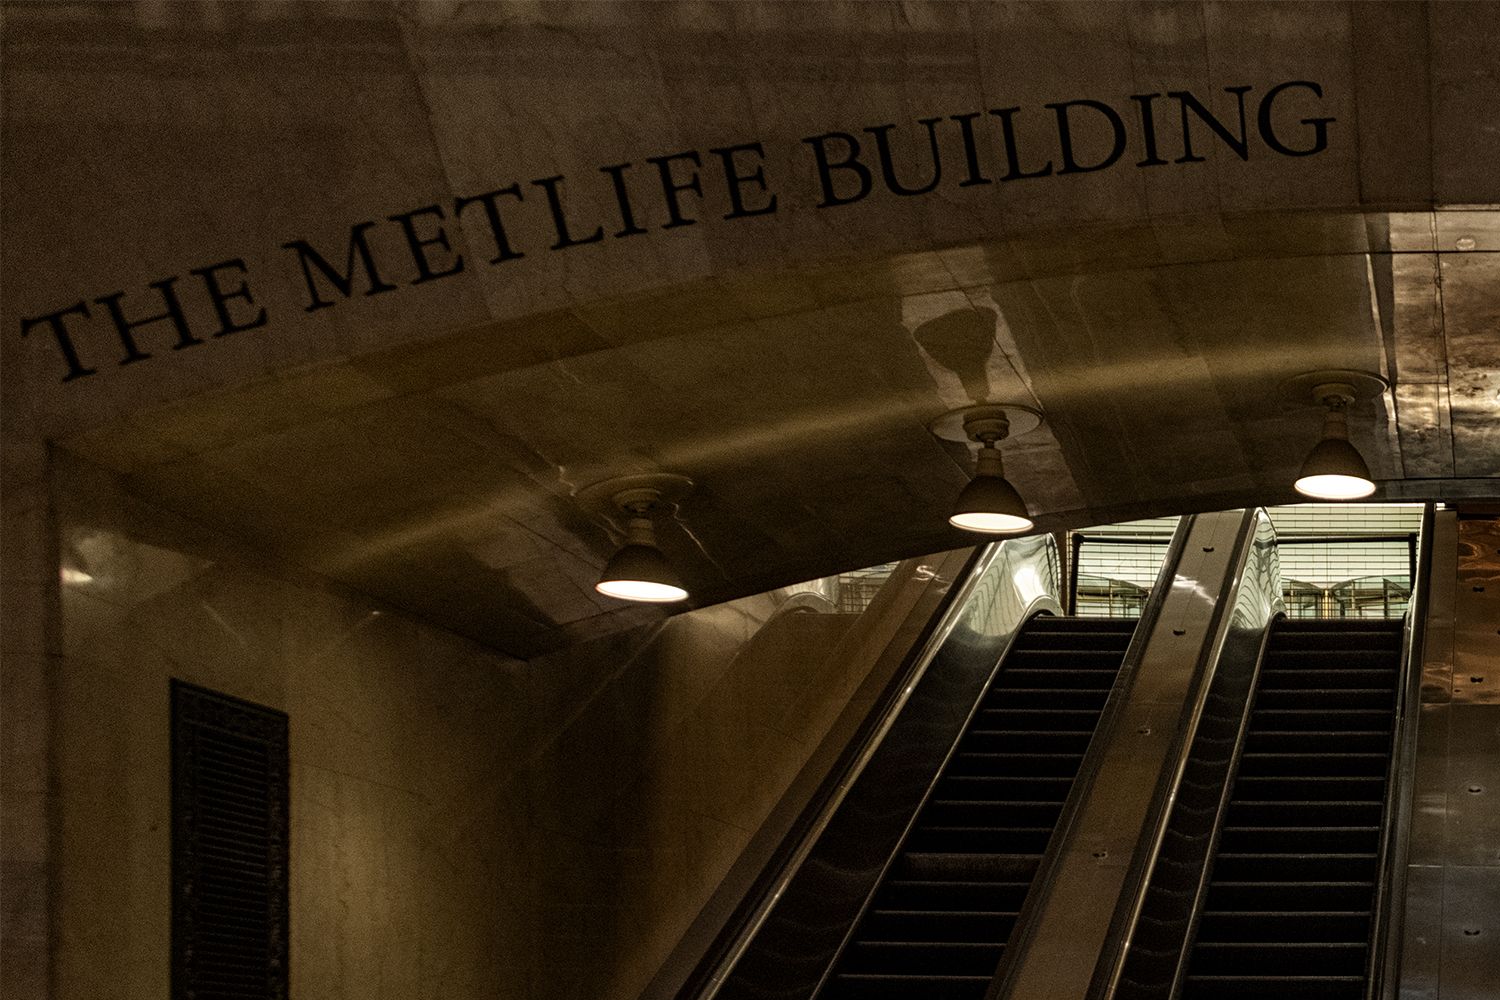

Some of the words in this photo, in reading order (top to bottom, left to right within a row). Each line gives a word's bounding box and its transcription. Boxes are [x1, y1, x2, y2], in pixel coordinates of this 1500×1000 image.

[21, 259, 267, 382] THE
[282, 142, 777, 312] METLIFE
[803, 81, 1335, 208] BUILDING
